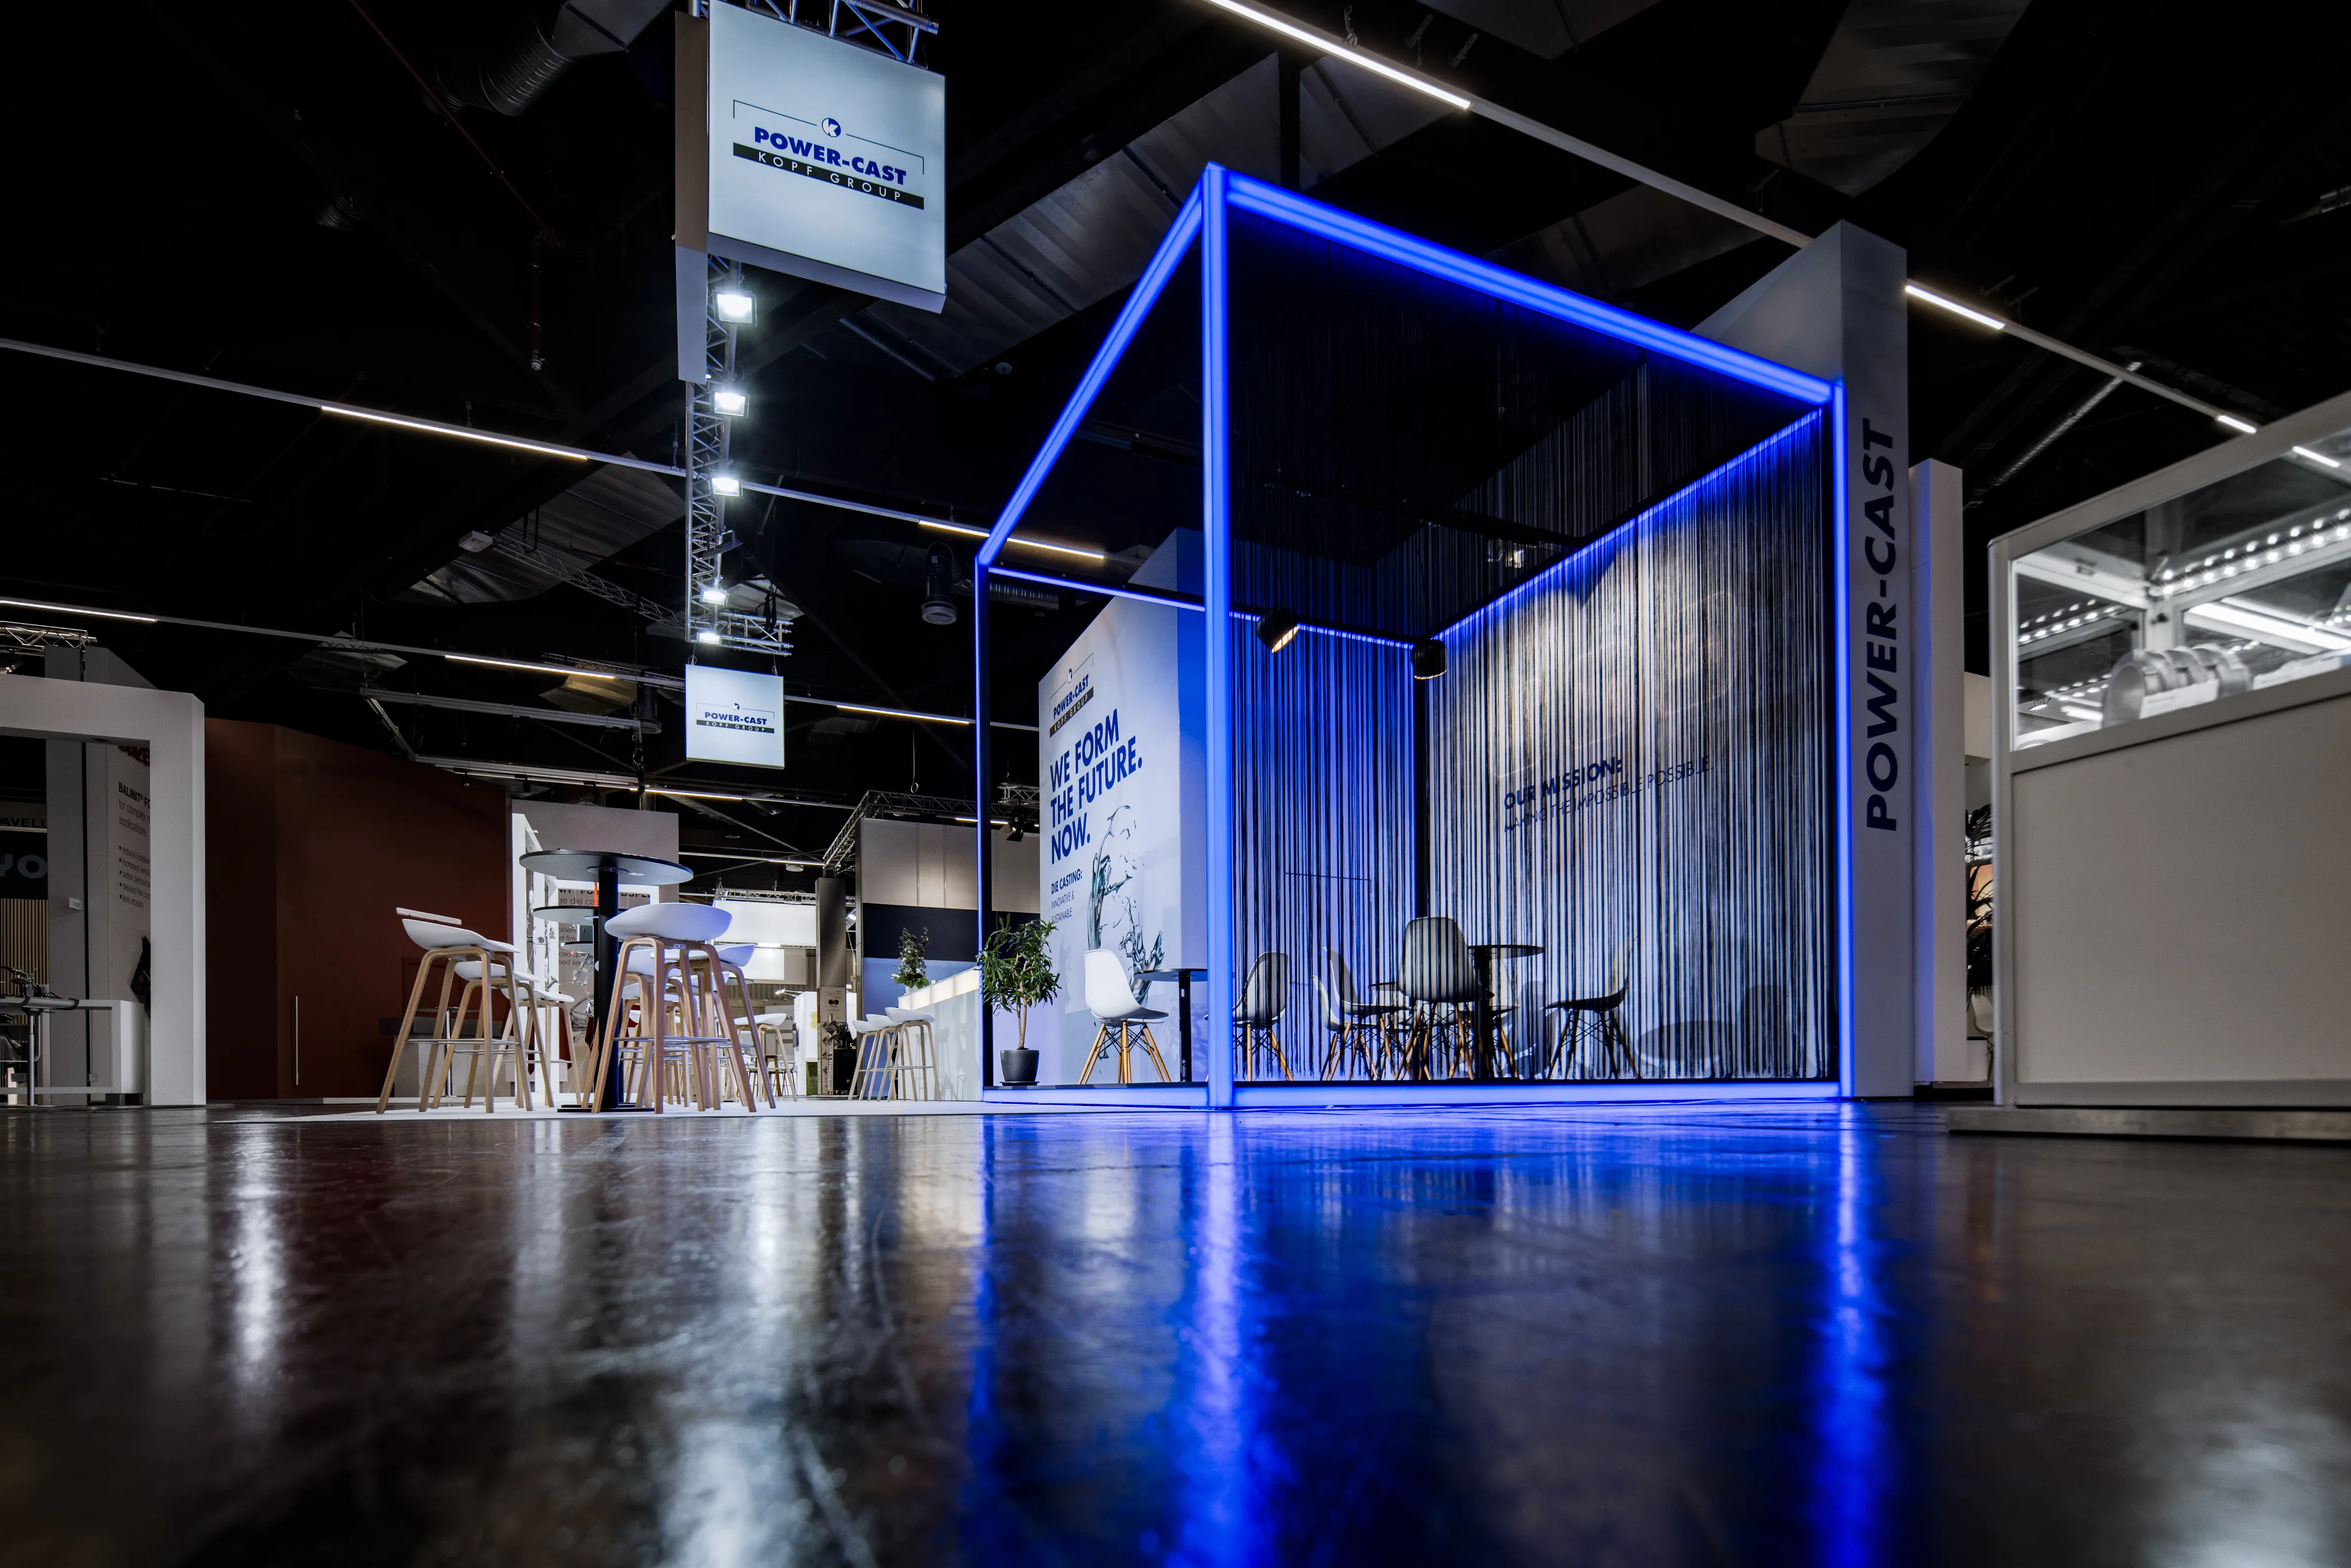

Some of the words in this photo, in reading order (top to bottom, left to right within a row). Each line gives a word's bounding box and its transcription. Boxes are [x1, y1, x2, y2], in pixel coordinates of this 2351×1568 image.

[754, 126, 907, 185] POWER-CAST
[759, 152, 812, 175] KOPF
[830, 173, 900, 201] GROUP
[1863, 417, 1898, 831] POWER-CAST
[1053, 674, 1089, 720] POWER-CAST
[705, 712, 767, 725] POWER-CAST
[1054, 715, 1067, 731] KOPF
[1069, 694, 1088, 717] GROUP
[1050, 750, 1070, 793] WE
[1075, 708, 1119, 774] FORM
[1050, 785, 1073, 828] THE
[1078, 735, 1142, 810] FUTURE.
[1504, 784, 1536, 809] OUR
[1542, 756, 1623, 798] MISSION:
[126, 804, 146, 821] complex
[1550, 798, 1570, 819] THE
[0, 817, 47, 828] AVELL
[119, 816, 146, 837] applications
[1052, 812, 1091, 864] NOW.
[122, 847, 137, 859] reduced
[122, 857, 139, 872] increased
[1060, 868, 1083, 890] CASTING:
[131, 898, 143, 908] erosion
[1052, 892, 1070, 909] INNOVATIVE
[1072, 891, 1074, 900] &
[1052, 907, 1072, 925] SUSTAINABLE
